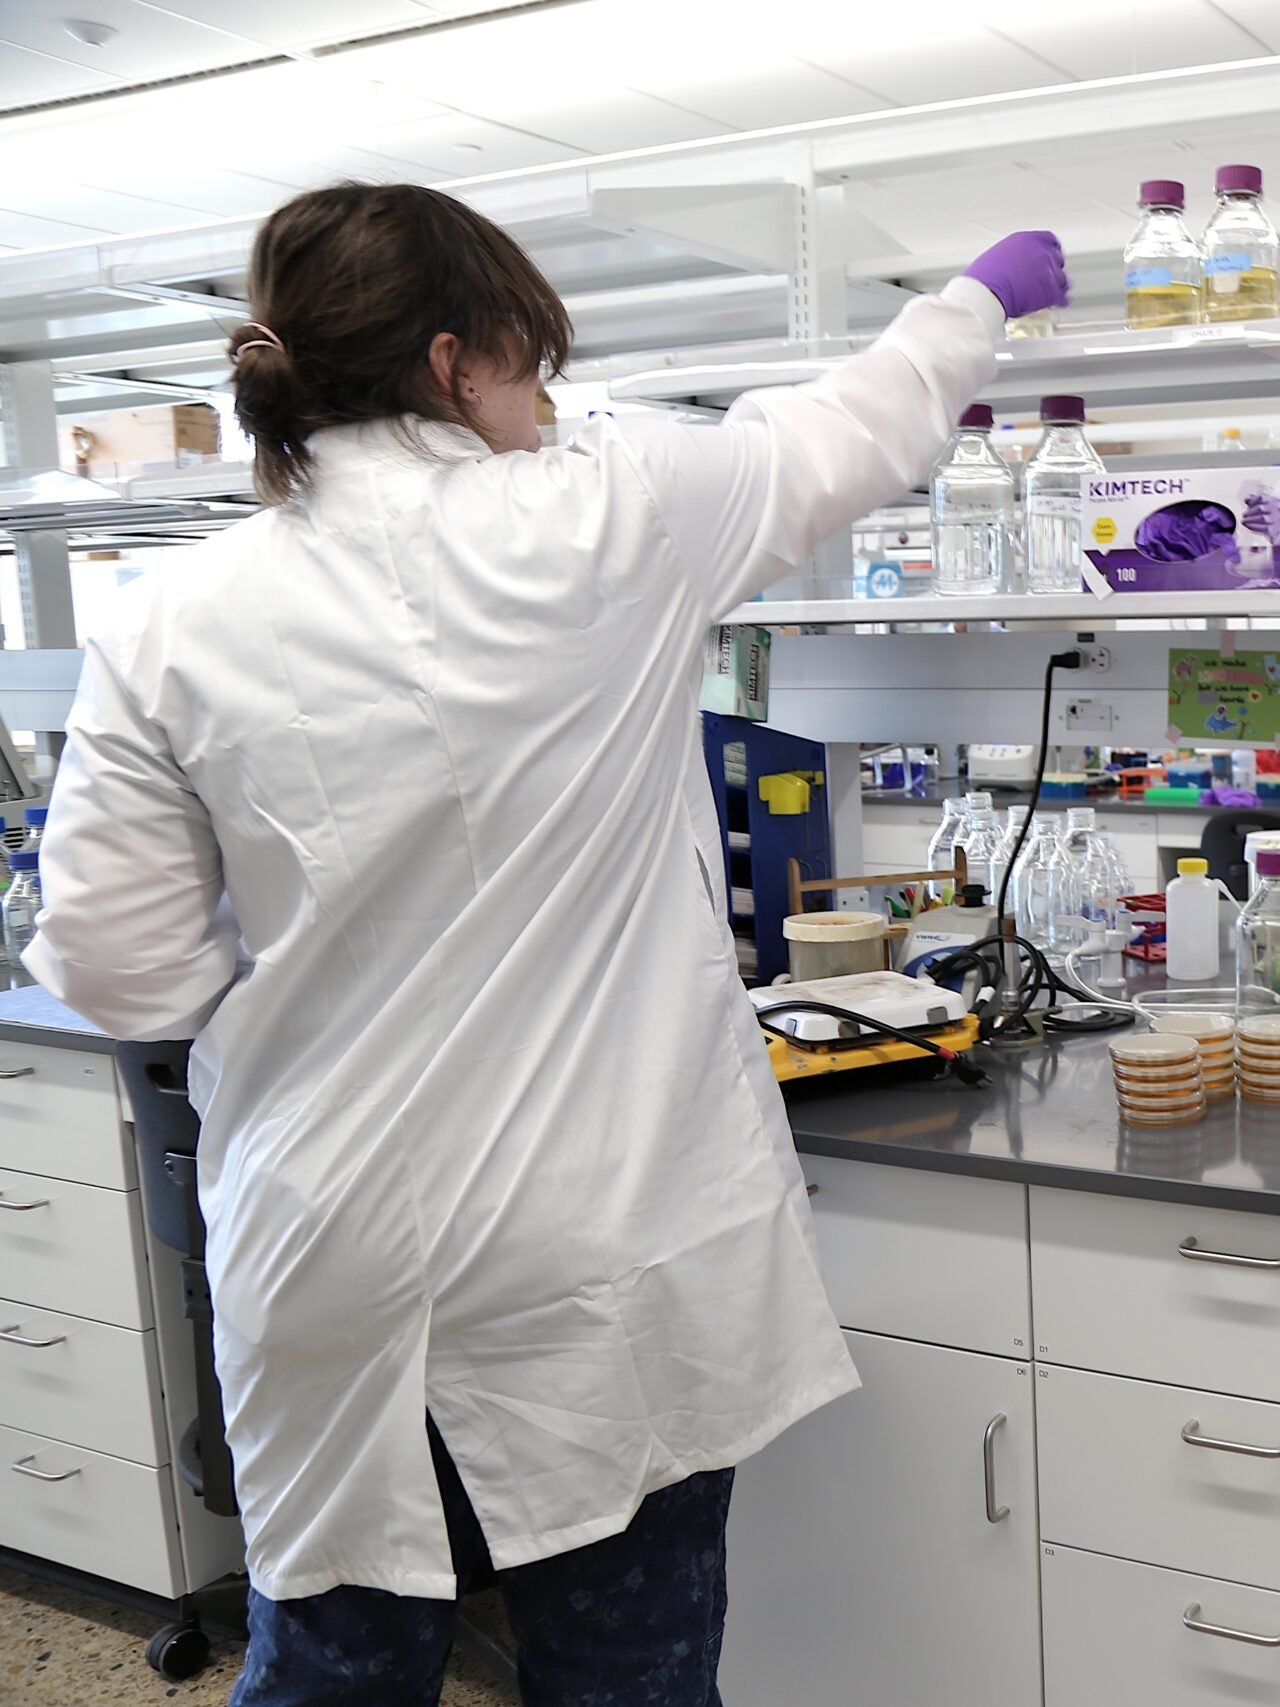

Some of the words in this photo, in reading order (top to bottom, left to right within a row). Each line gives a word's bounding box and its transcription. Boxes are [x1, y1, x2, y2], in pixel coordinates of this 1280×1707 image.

[1089, 479, 1184, 497] KIMTECH
[1116, 568, 1137, 582] 100
[721, 625, 732, 675] KIMTECH
[1013, 1338, 1024, 1347] D5
[1039, 1345, 1048, 1353] D1
[1039, 1370, 1049, 1378] D2
